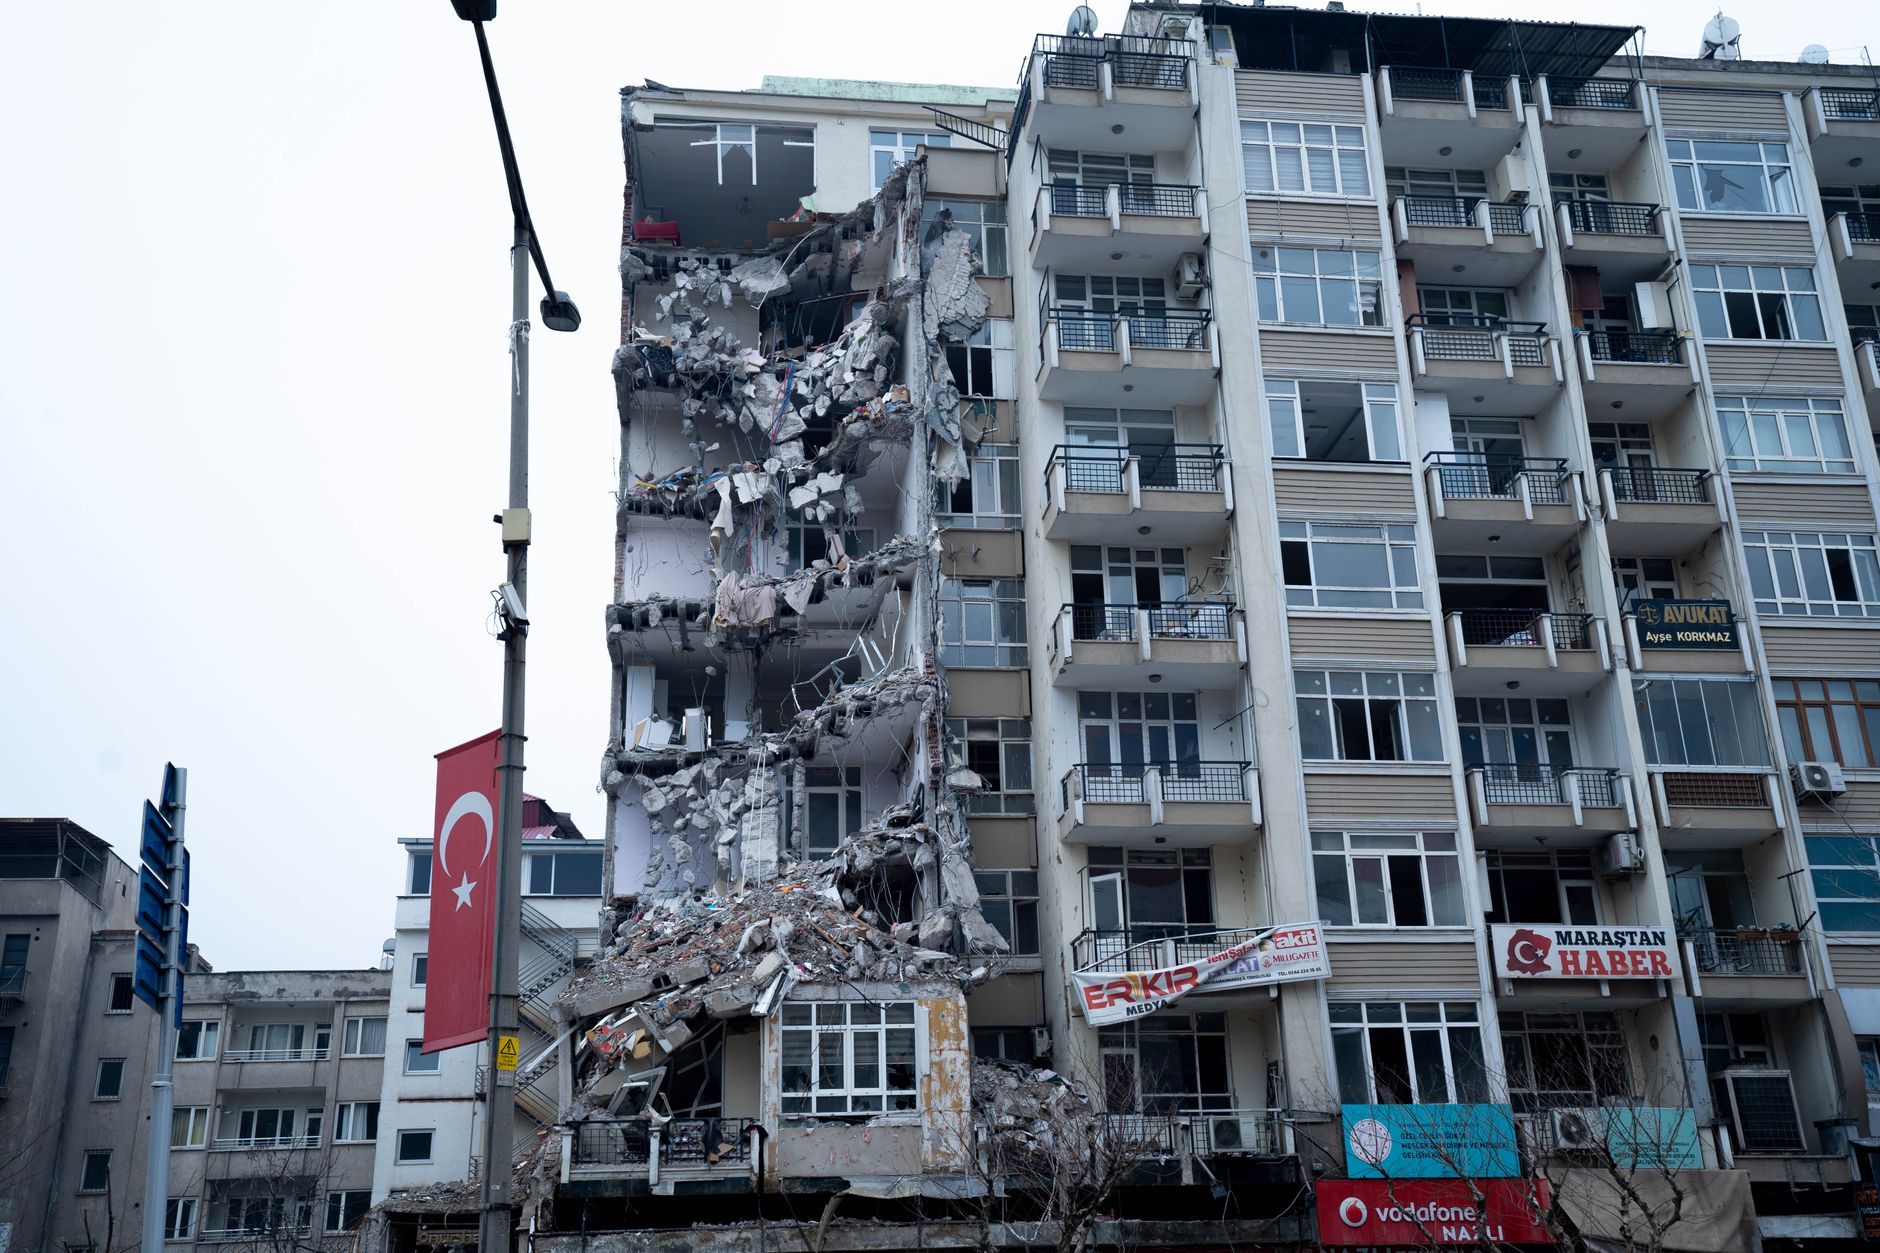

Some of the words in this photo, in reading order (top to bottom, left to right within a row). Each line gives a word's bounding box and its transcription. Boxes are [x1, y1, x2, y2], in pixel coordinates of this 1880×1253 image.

[1664, 605, 1728, 624] AVUKAT
[1646, 631, 1672, 644] Ayşe
[1677, 632, 1731, 642] KORKMAZ
[1275, 930, 1317, 949] akit
[1555, 931, 1666, 948] MARAŞTAN
[1558, 950, 1672, 976] HABER
[1126, 999, 1168, 1017] MEDYA
[1375, 1201, 1477, 1222] vodafone
